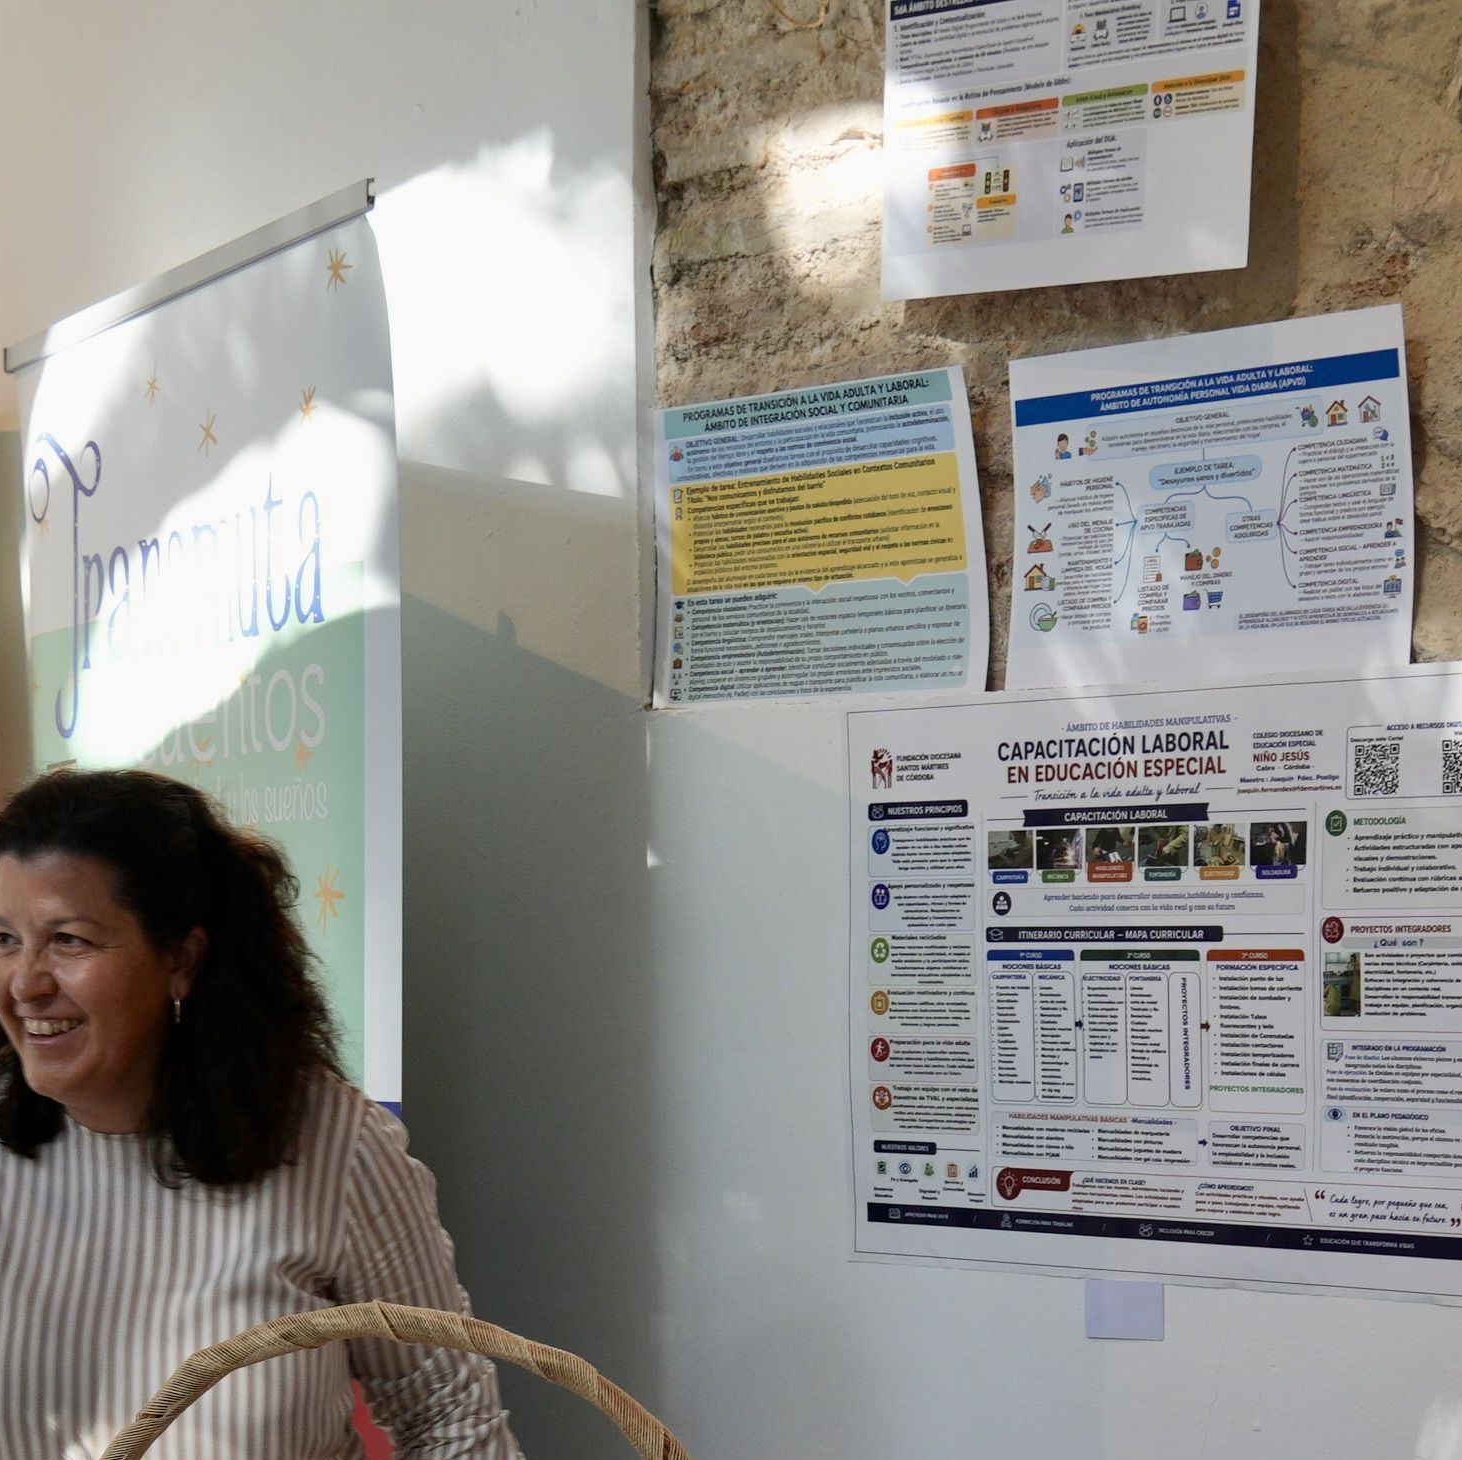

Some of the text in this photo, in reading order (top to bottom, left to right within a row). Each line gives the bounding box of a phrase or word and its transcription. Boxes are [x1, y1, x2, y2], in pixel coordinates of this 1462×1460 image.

[1091, 365, 1313, 402] PROGRAMAS DE TRANSICIÓN A LA VIDA ADULTA Y LABORAL:
[683, 379, 929, 422] PROGRAMAS DE TRANSICIÓN A LA VIDA ADULTA Y LABORAL:
[1100, 378, 1306, 411] ÁMBITO DE AUTONOMÍA PERSONAL VIDA DIARIA (APVD)
[705, 395, 908, 432] ÁMBITO DE INTEGRACIÓN SOCIAL Y COMUNITARIA
[1174, 462, 1235, 474] EJEMPLO DE TAREA:
[1066, 715, 1231, 733] ÁMBITO DE HABILIDADES MANIPULATIVAS
[1280, 730, 1314, 738] DIOCESANO
[998, 731, 1229, 761] CAPACITACIÓN LABORAL
[1253, 740, 1287, 749] EDUCACIÓN
[897, 753, 929, 761] FUNDACIÓN
[1253, 750, 1309, 762] NIÑO JESÚS
[921, 762, 949, 770] MÁRTIRES
[1007, 756, 1226, 784] EN EDUCACIÓN ESPECIAL
[1091, 788, 1099, 798] la
[1102, 787, 1120, 798] vida
[1126, 785, 1153, 797] adulta
[1155, 789, 1162, 798] y
[1166, 783, 1200, 795] laboral
[264, 775, 328, 823] sueños
[888, 805, 962, 815] NUESTROS PRINCIPIOS
[1064, 809, 1168, 822] CAPACITACIÓN LABORAL
[1354, 815, 1406, 826] METODOLOGÍA
[1018, 930, 1204, 939] ITINERARIO CURRICULAR MAPA CURRICULAR
[1395, 925, 1451, 933] INTEGRADORES
[1182, 1027, 1190, 1090] INTEGRADORES
[1251, 1086, 1304, 1094] INTEGRADORES
[1022, 1176, 1061, 1185] CONCLUSIÓN
